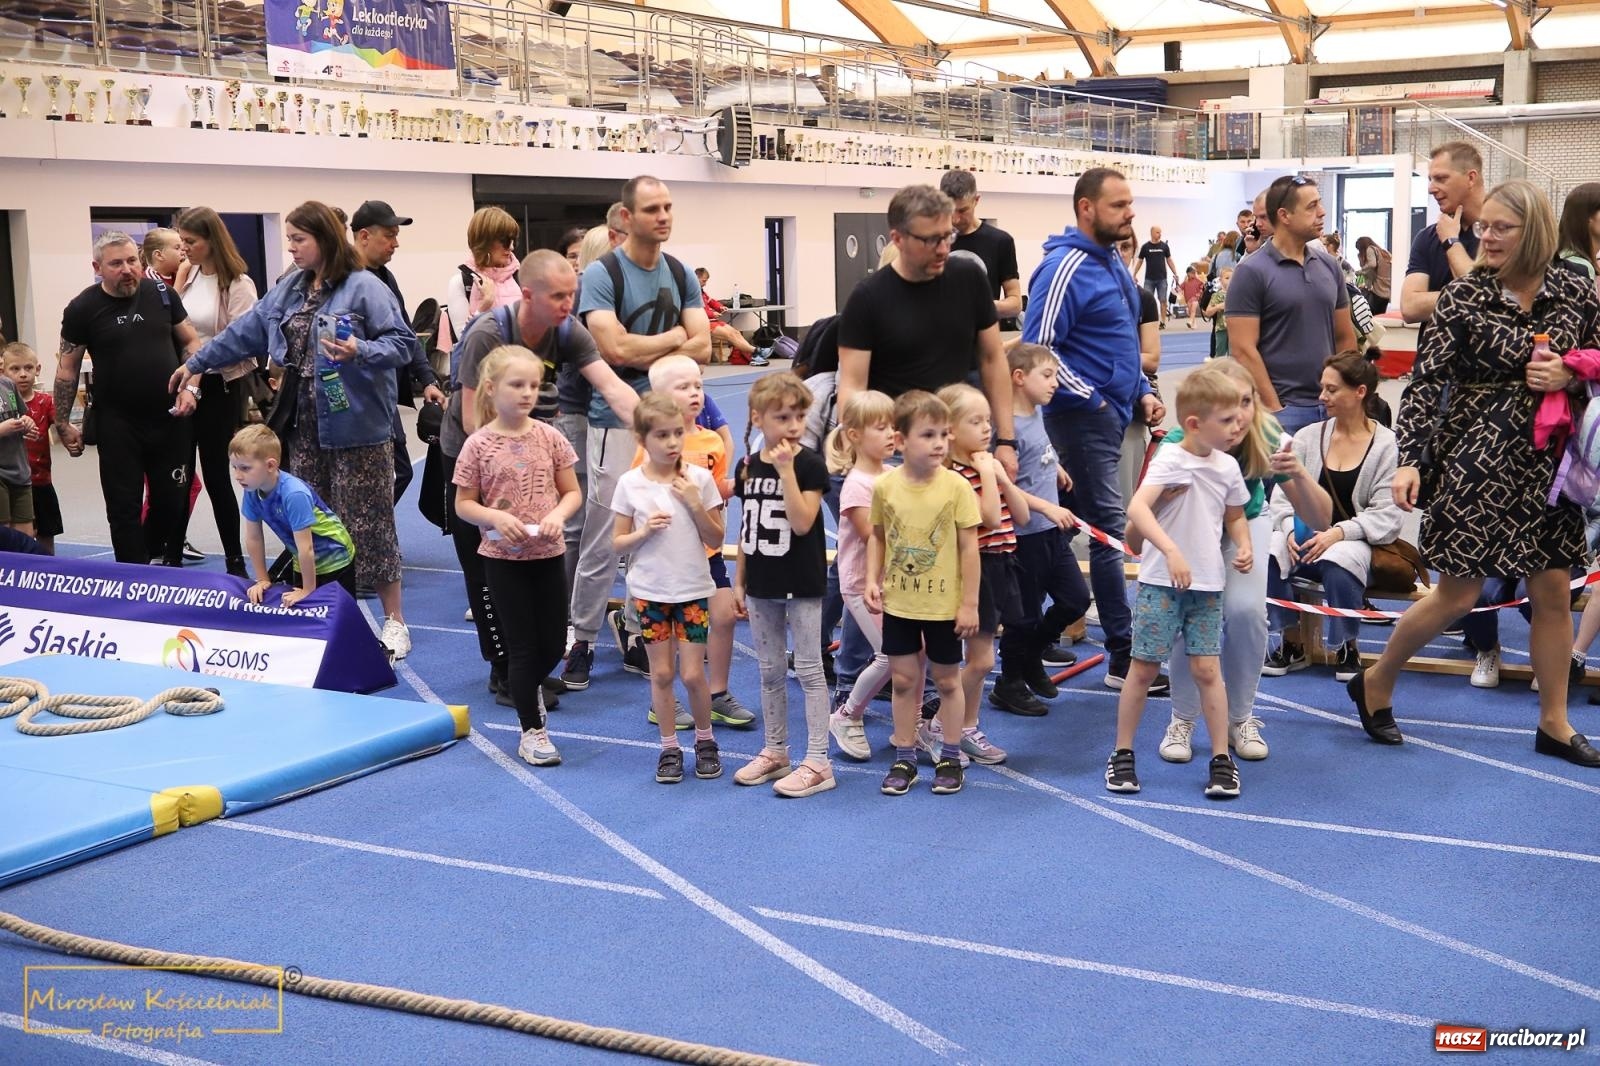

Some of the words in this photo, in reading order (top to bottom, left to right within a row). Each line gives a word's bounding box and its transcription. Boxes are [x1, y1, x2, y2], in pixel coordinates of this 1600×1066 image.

[352, 6, 428, 31] Lekkoatletyka
[351, 25, 363, 35] dla
[365, 26, 393, 39] każdego!
[741, 499, 791, 557] 05
[18, 570, 125, 599] MISTRZOSTWA
[126, 582, 227, 609] SPORTOWEGO
[206, 648, 269, 671] ZSOMS
